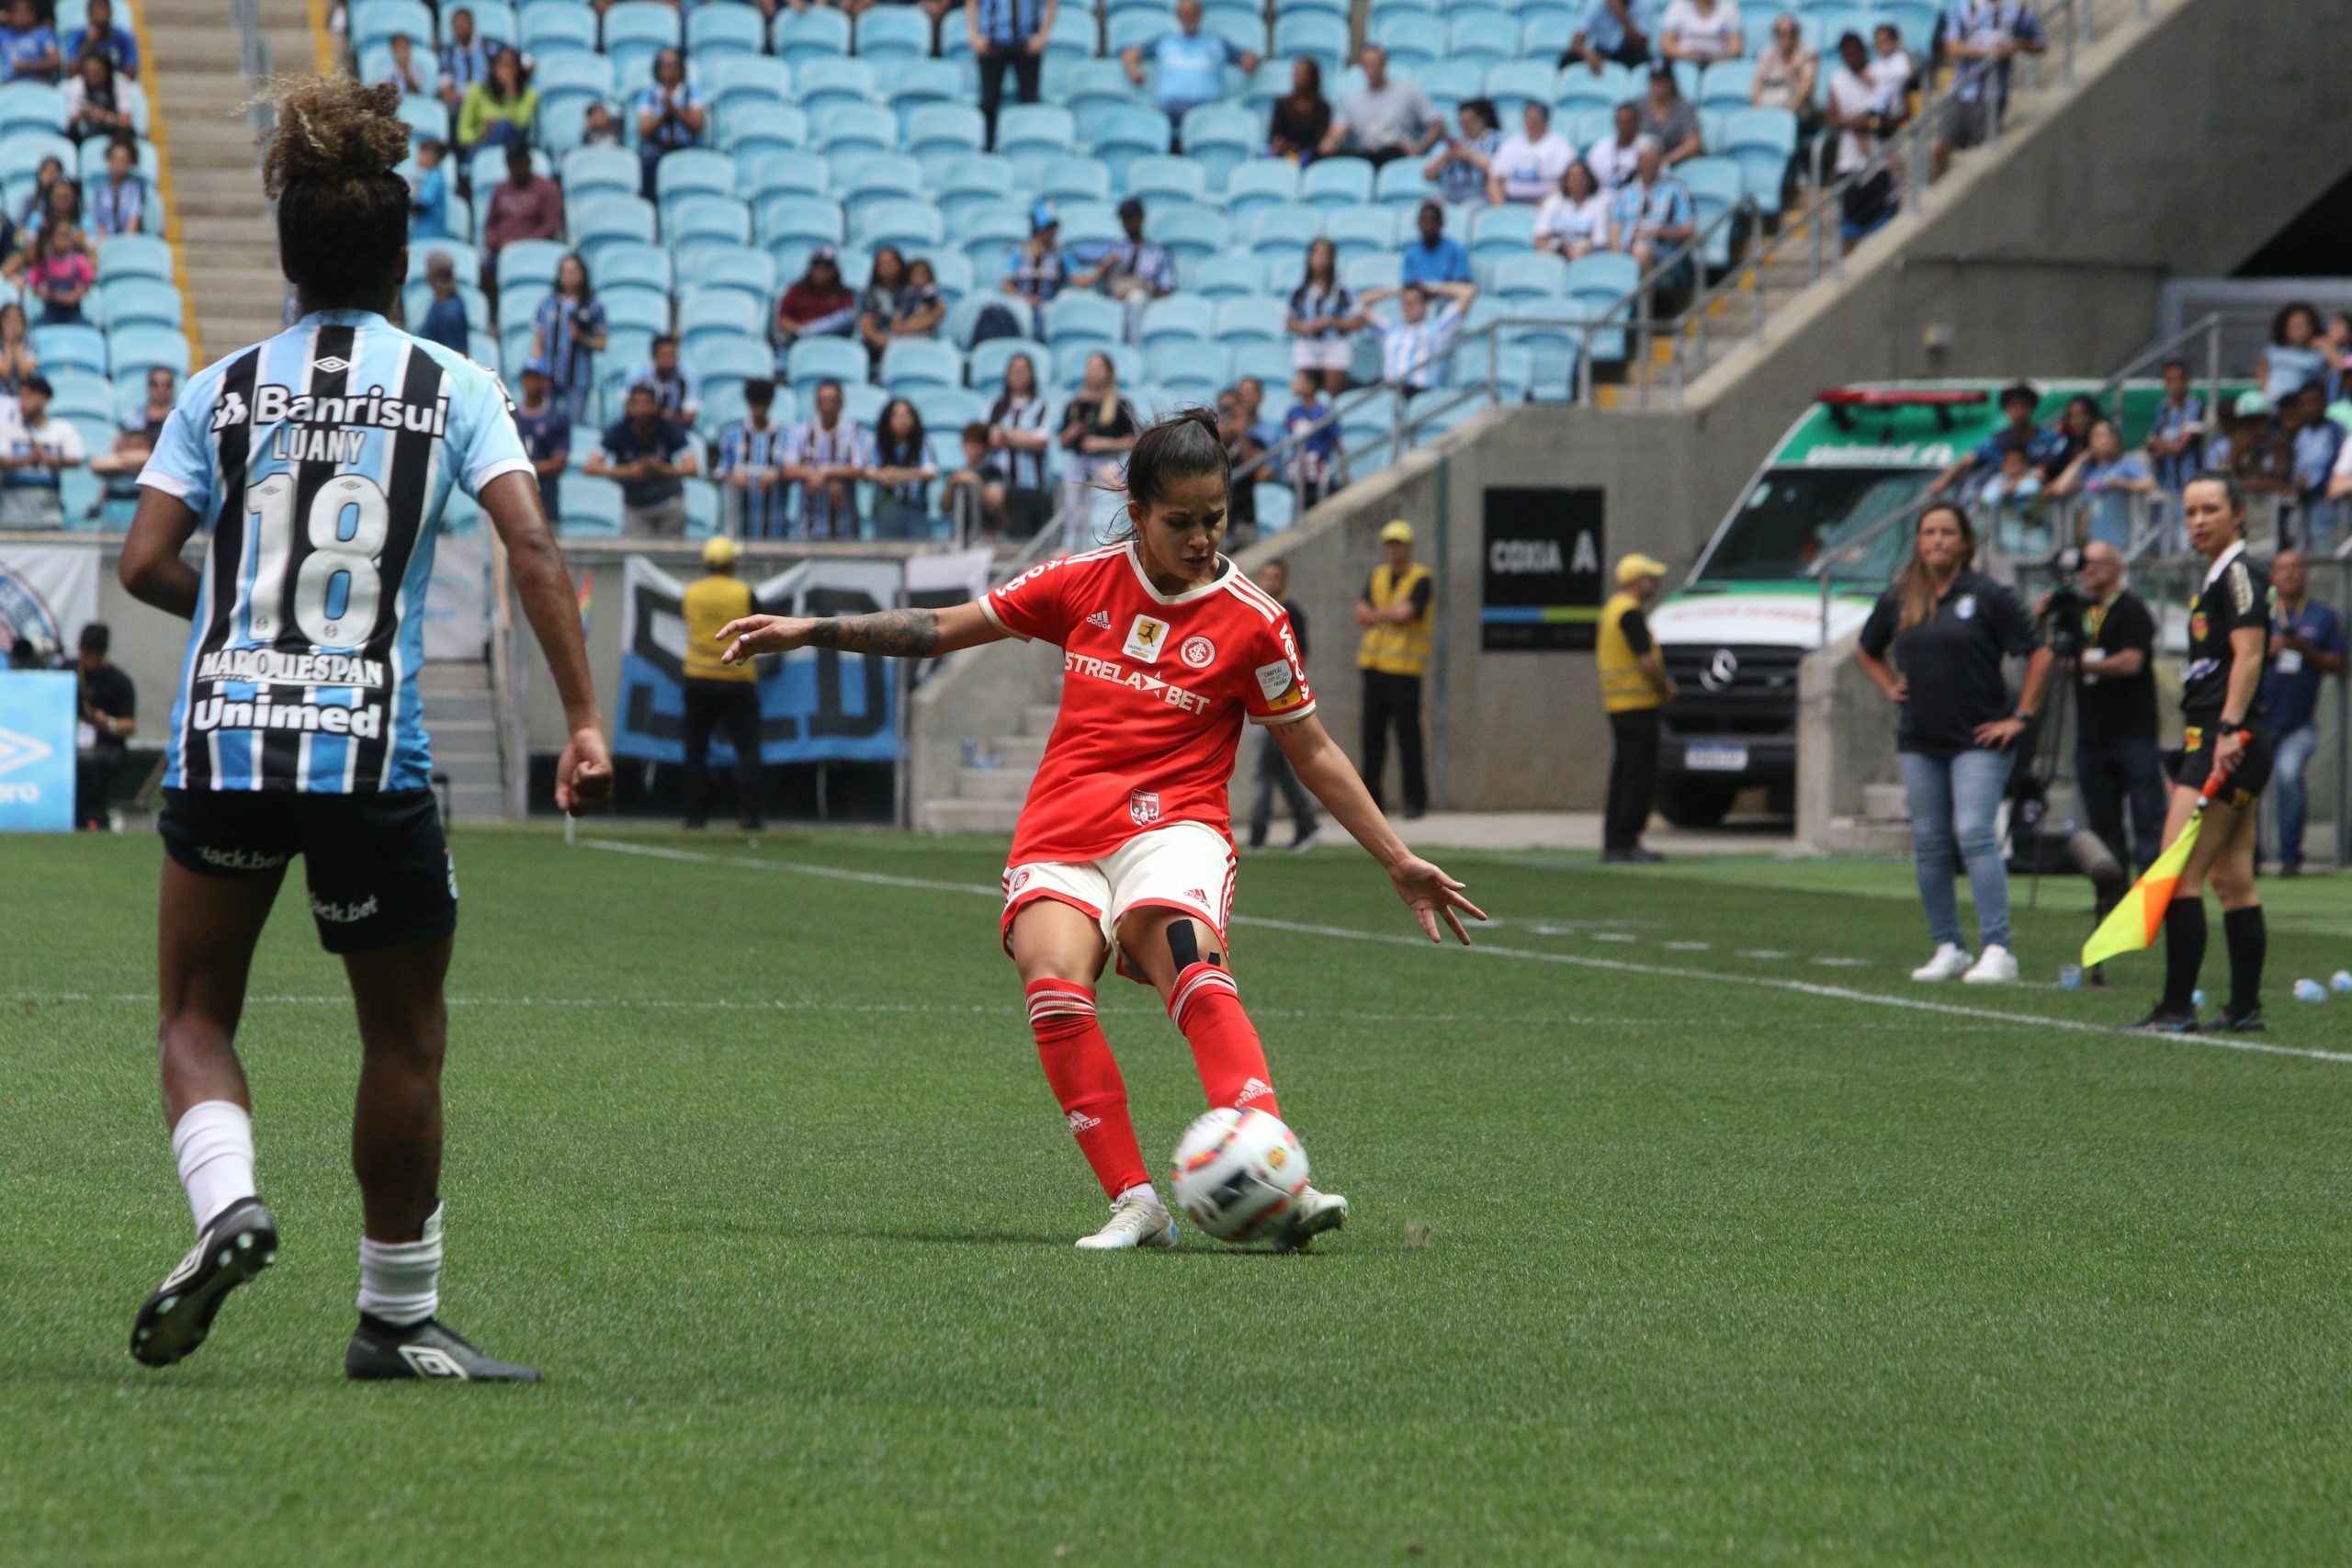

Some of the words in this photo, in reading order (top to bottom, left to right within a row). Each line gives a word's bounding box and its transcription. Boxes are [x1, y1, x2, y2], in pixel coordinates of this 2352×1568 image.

[255, 385, 448, 437] Banrisul
[273, 426, 366, 464] LUANY
[245, 472, 390, 649] 18
[1570, 527, 1599, 574] A
[1086, 616, 1112, 630] adidas
[1064, 650, 1142, 691] STRELA
[1164, 685, 1211, 716] BET
[192, 694, 382, 739] Unimed
